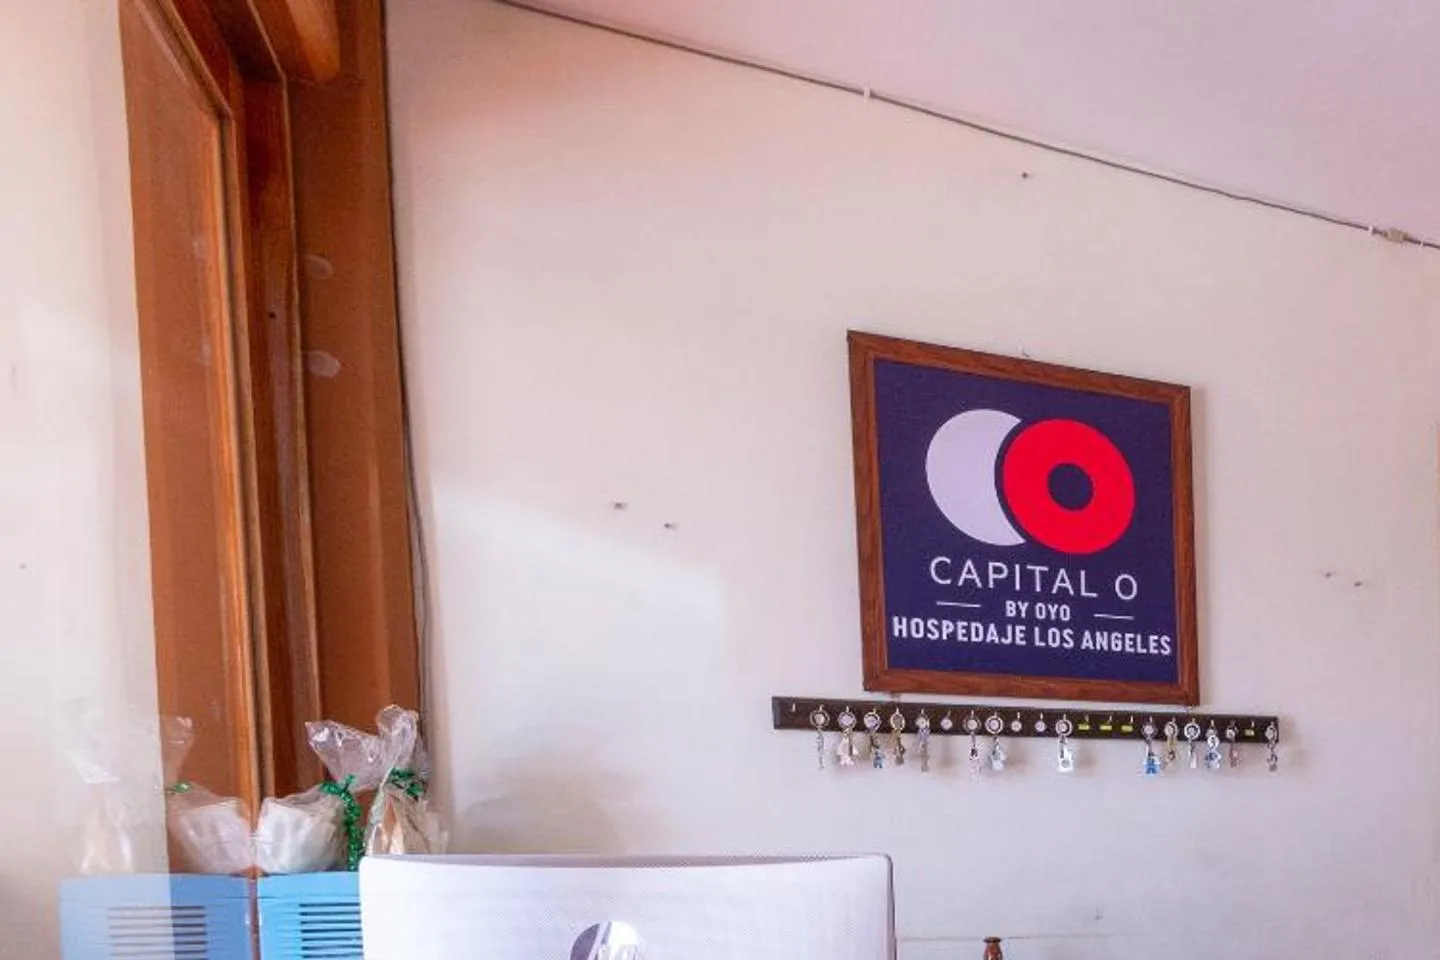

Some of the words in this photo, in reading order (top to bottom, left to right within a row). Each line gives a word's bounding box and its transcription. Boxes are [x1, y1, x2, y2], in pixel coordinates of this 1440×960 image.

[929, 555, 1099, 598] CAPITAL
[1114, 573, 1138, 600] O
[1005, 600, 1028, 618] BY
[1035, 602, 1071, 622] OYO
[892, 615, 1027, 646] HOSPEDAJE
[1033, 626, 1075, 649] LOS
[1081, 632, 1172, 656] ANGELES
